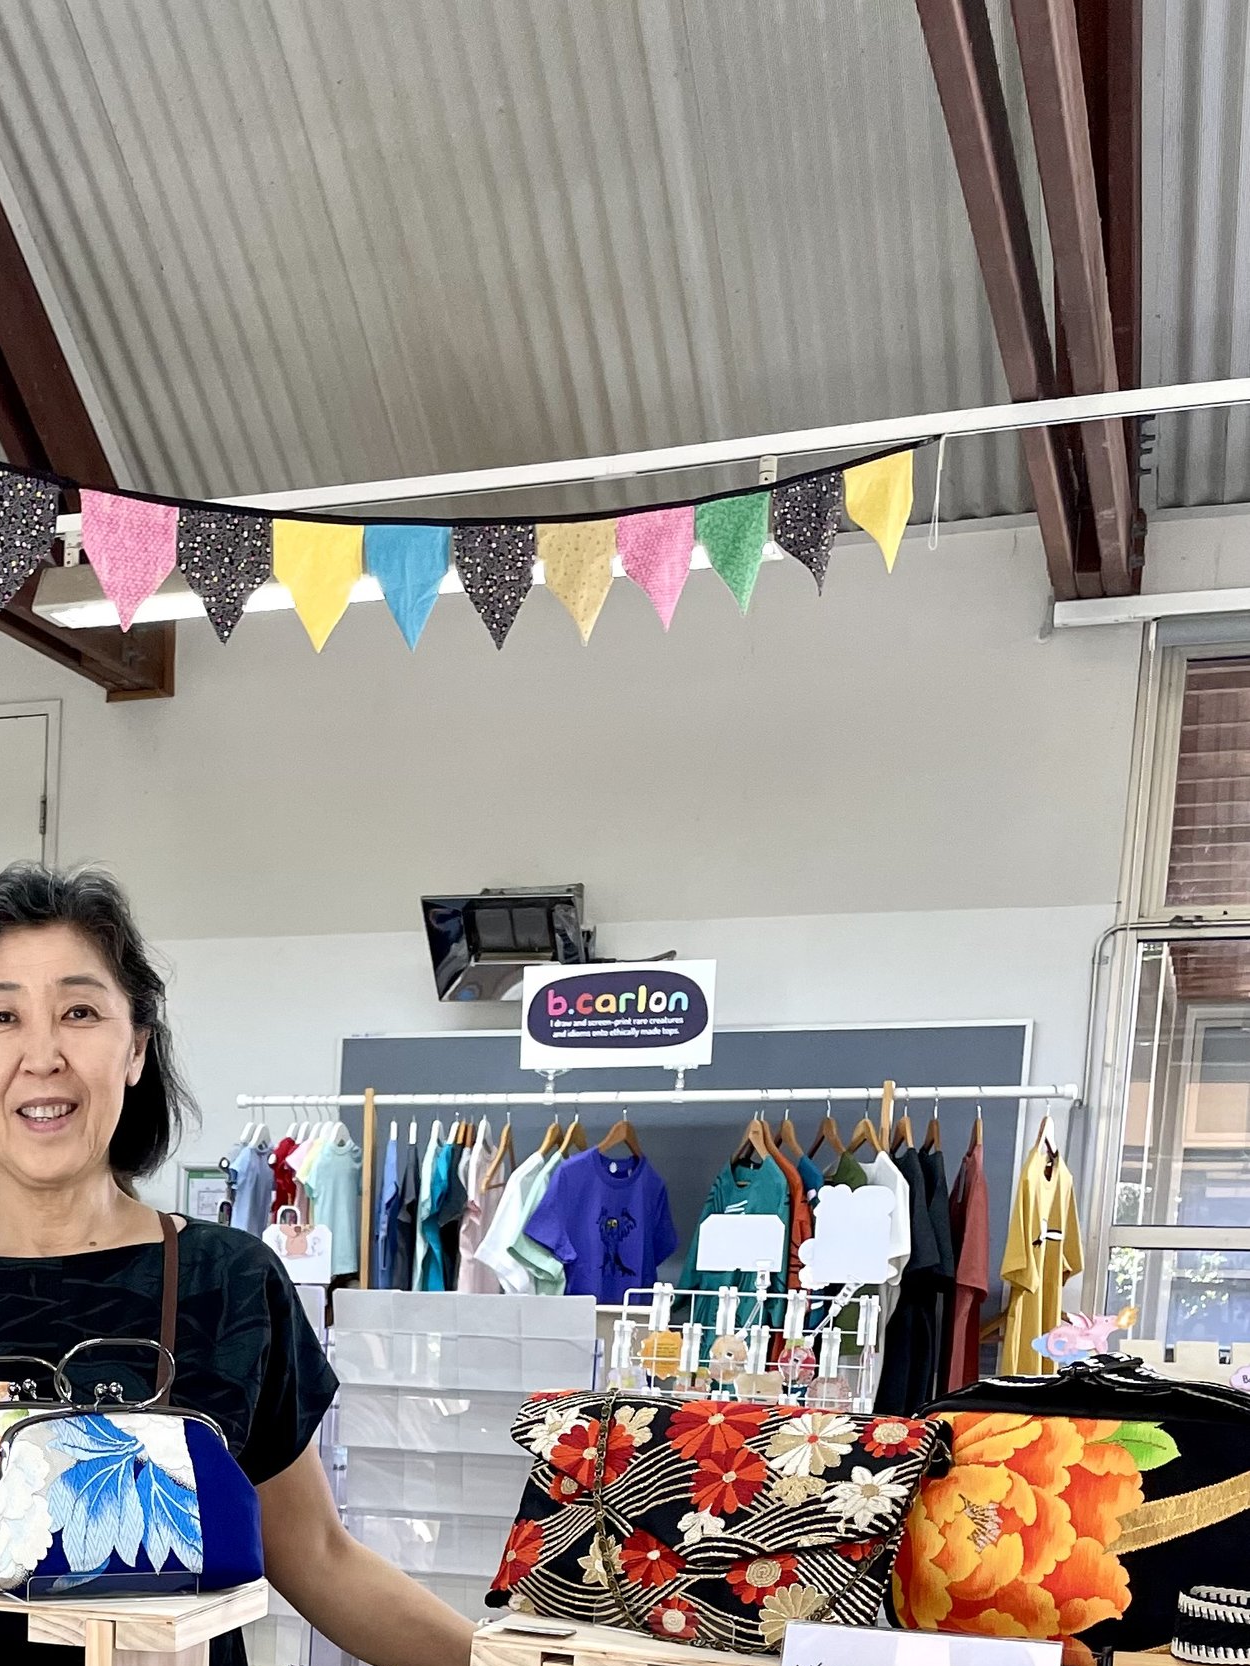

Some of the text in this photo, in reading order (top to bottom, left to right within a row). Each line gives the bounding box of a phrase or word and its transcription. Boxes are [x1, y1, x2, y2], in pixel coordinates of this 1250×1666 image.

[547, 985, 689, 1016] b.carlon
[554, 1019, 572, 1027] draw
[573, 1019, 587, 1027] and
[588, 1018, 632, 1028] screen-print
[649, 1017, 684, 1025] creatures
[553, 1030, 566, 1038] and
[609, 1027, 639, 1037] ethically
[640, 1027, 661, 1035] made
